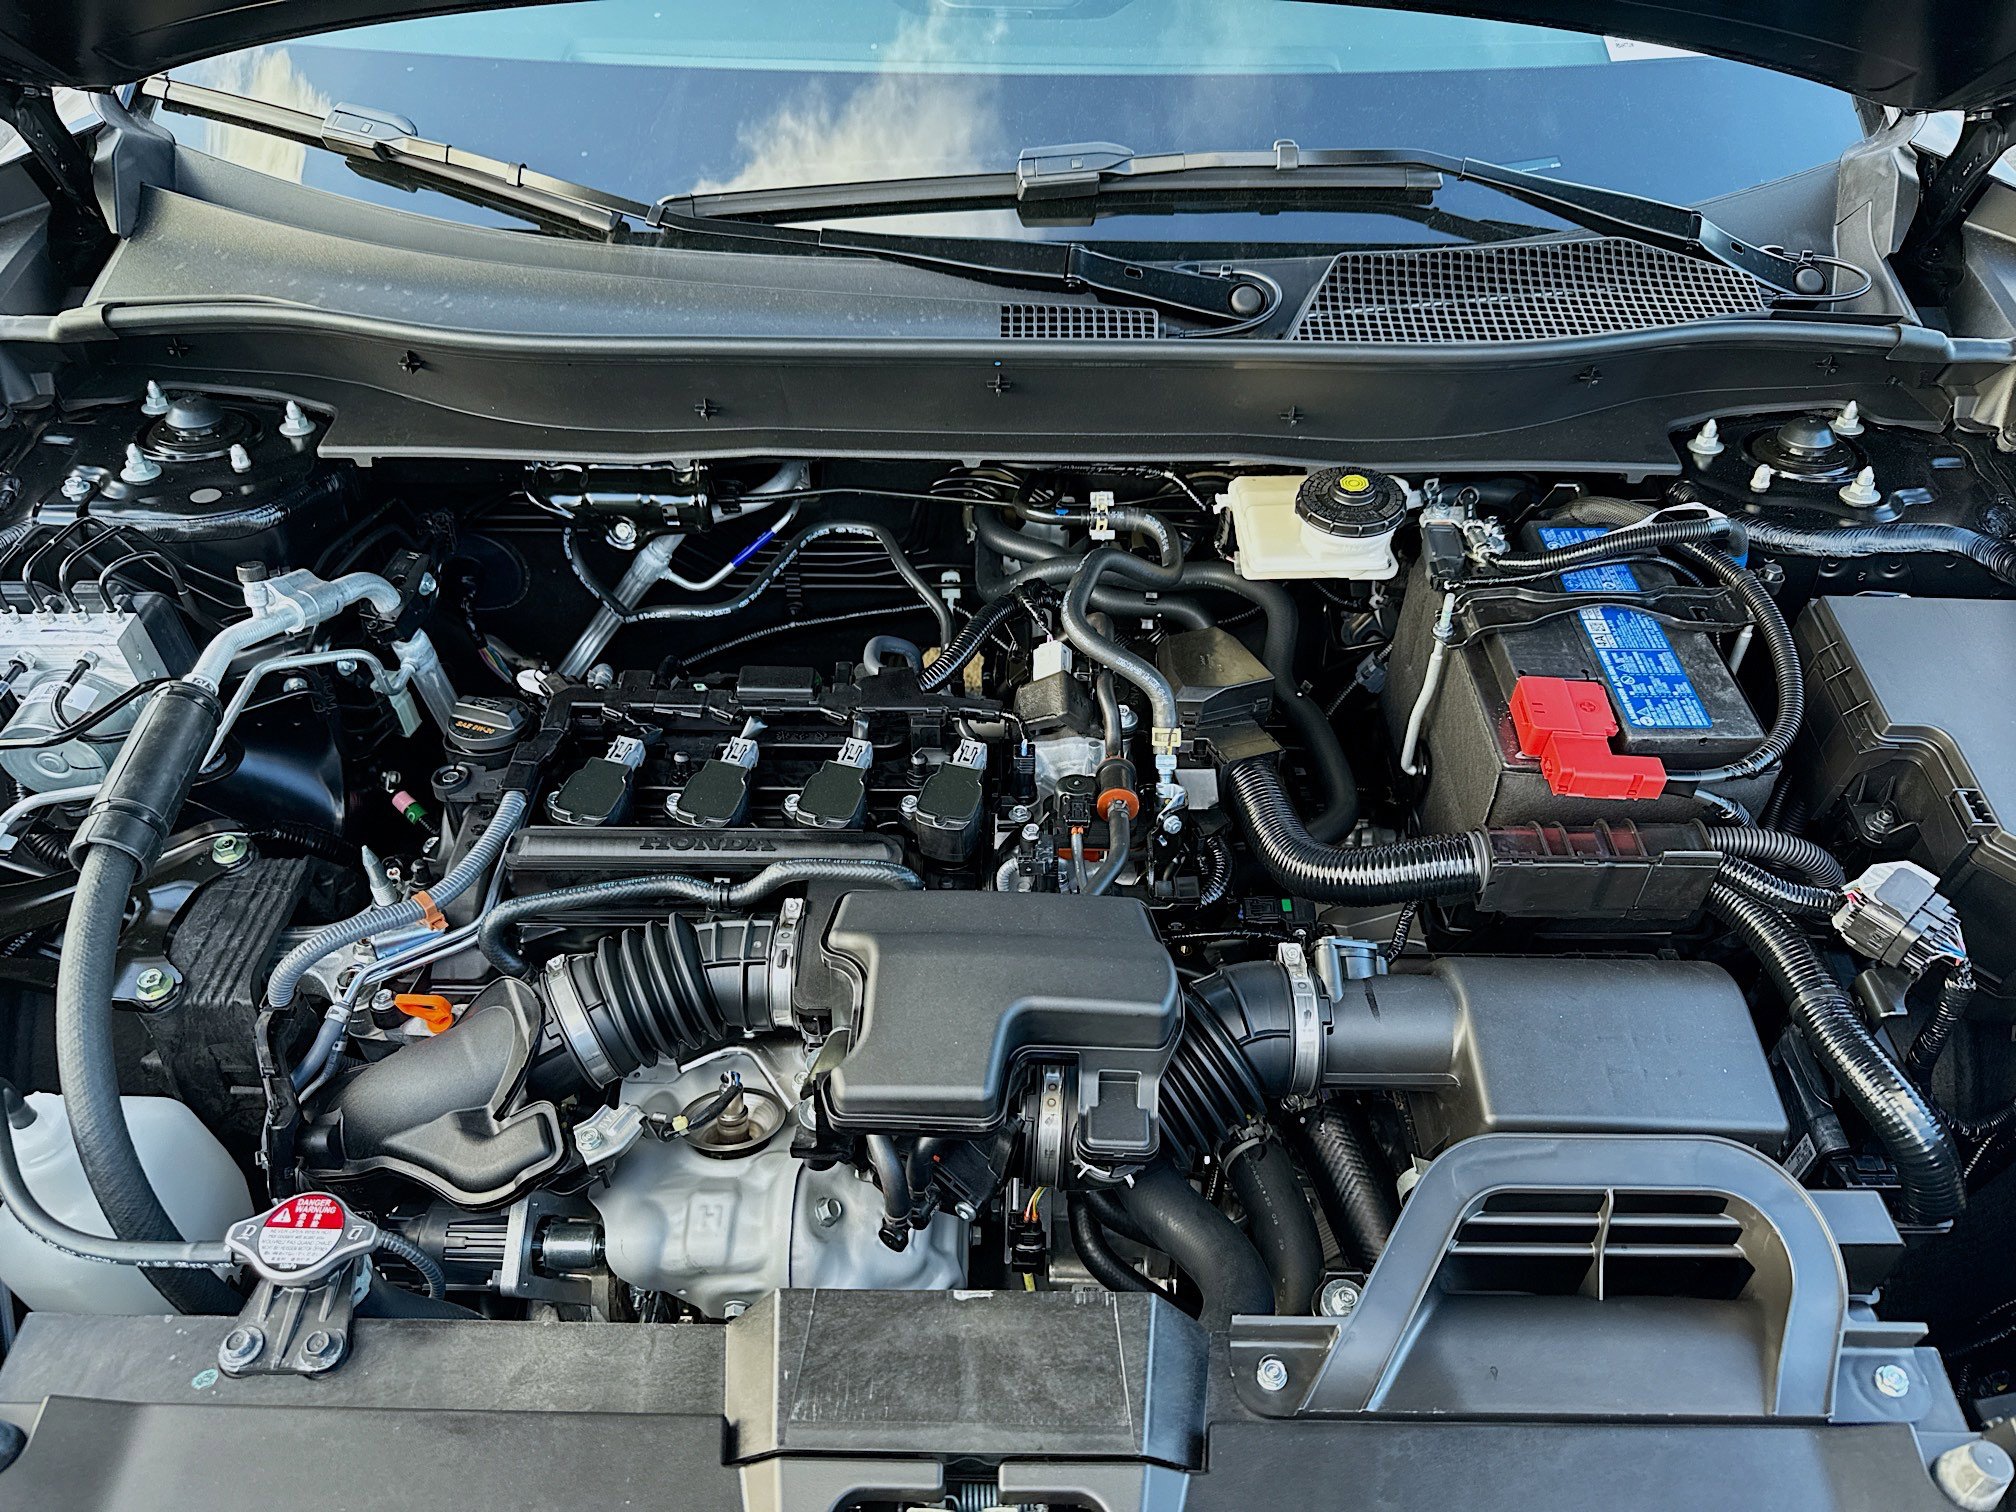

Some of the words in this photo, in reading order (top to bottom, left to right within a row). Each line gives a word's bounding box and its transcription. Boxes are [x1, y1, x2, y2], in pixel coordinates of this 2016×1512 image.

[455, 720, 474, 730] SAE
[639, 837, 777, 852] HONDA
[295, 1205, 337, 1214] WARNUNG
